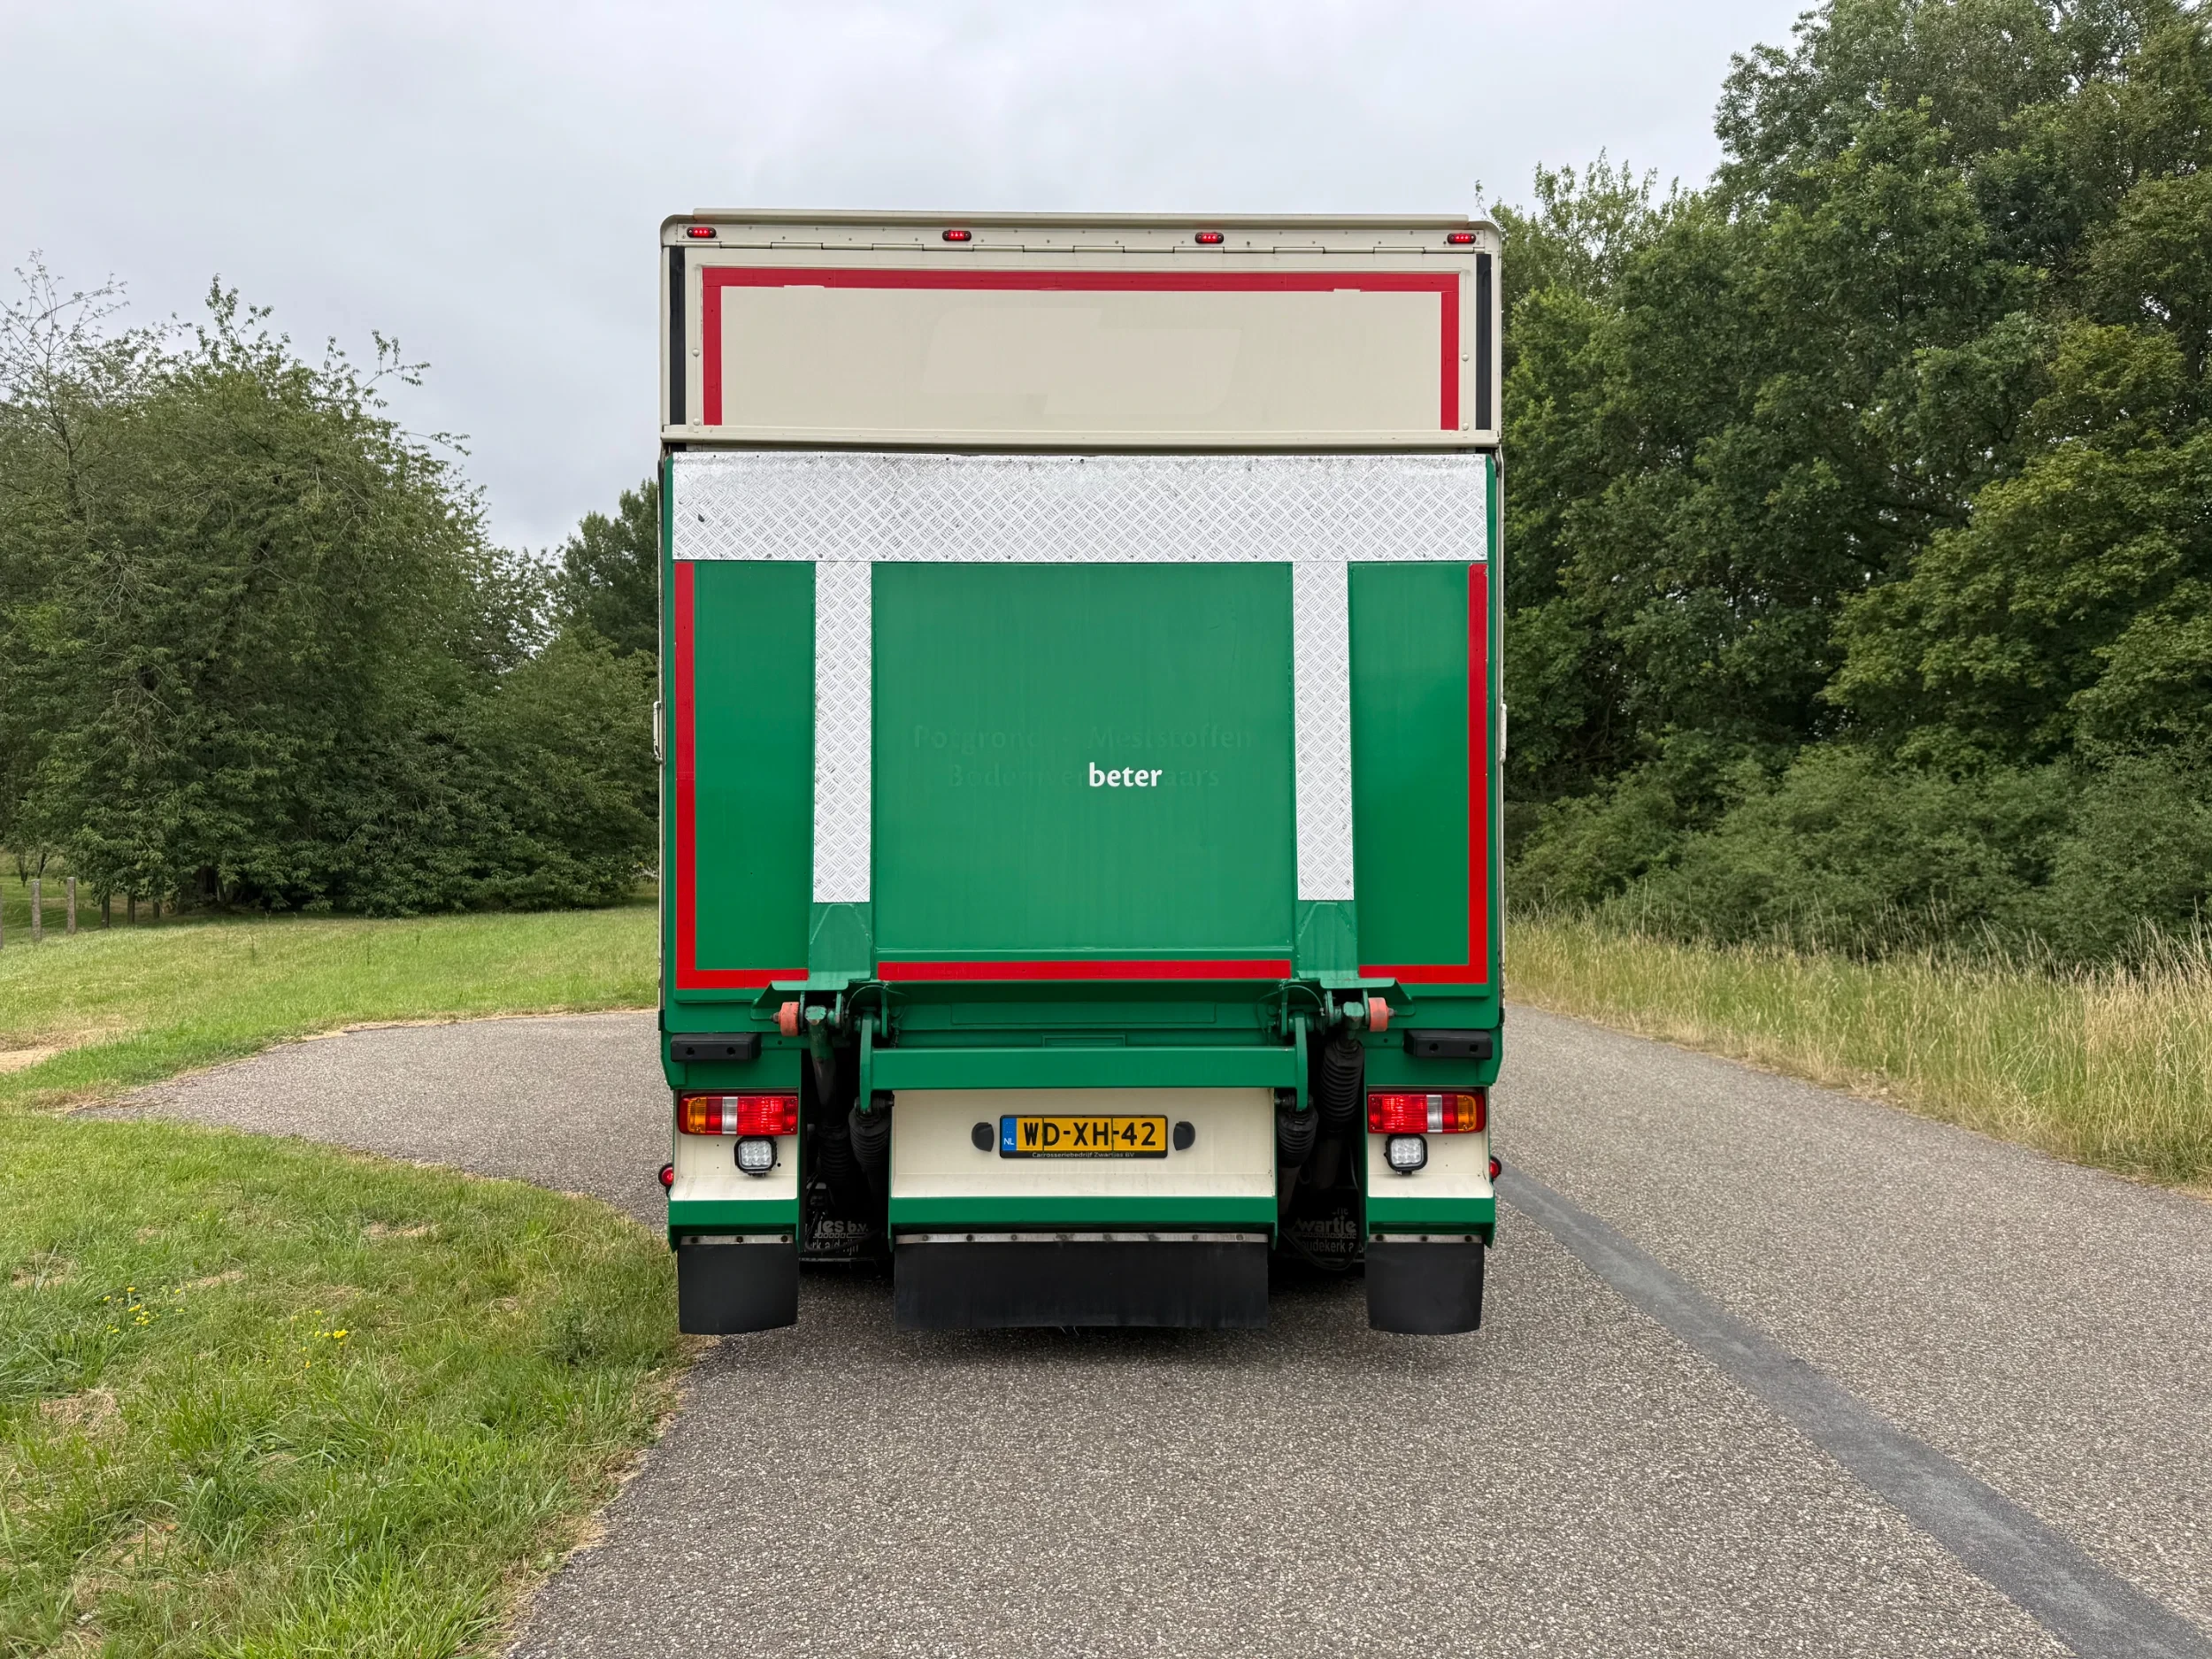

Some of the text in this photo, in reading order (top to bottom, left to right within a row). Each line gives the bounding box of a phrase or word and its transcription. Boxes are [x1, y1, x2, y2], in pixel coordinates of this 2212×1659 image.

[1088, 762, 1163, 787] beter
[1003, 1137, 1015, 1146] NL
[1023, 1122, 1156, 1147] WD-XH-42
